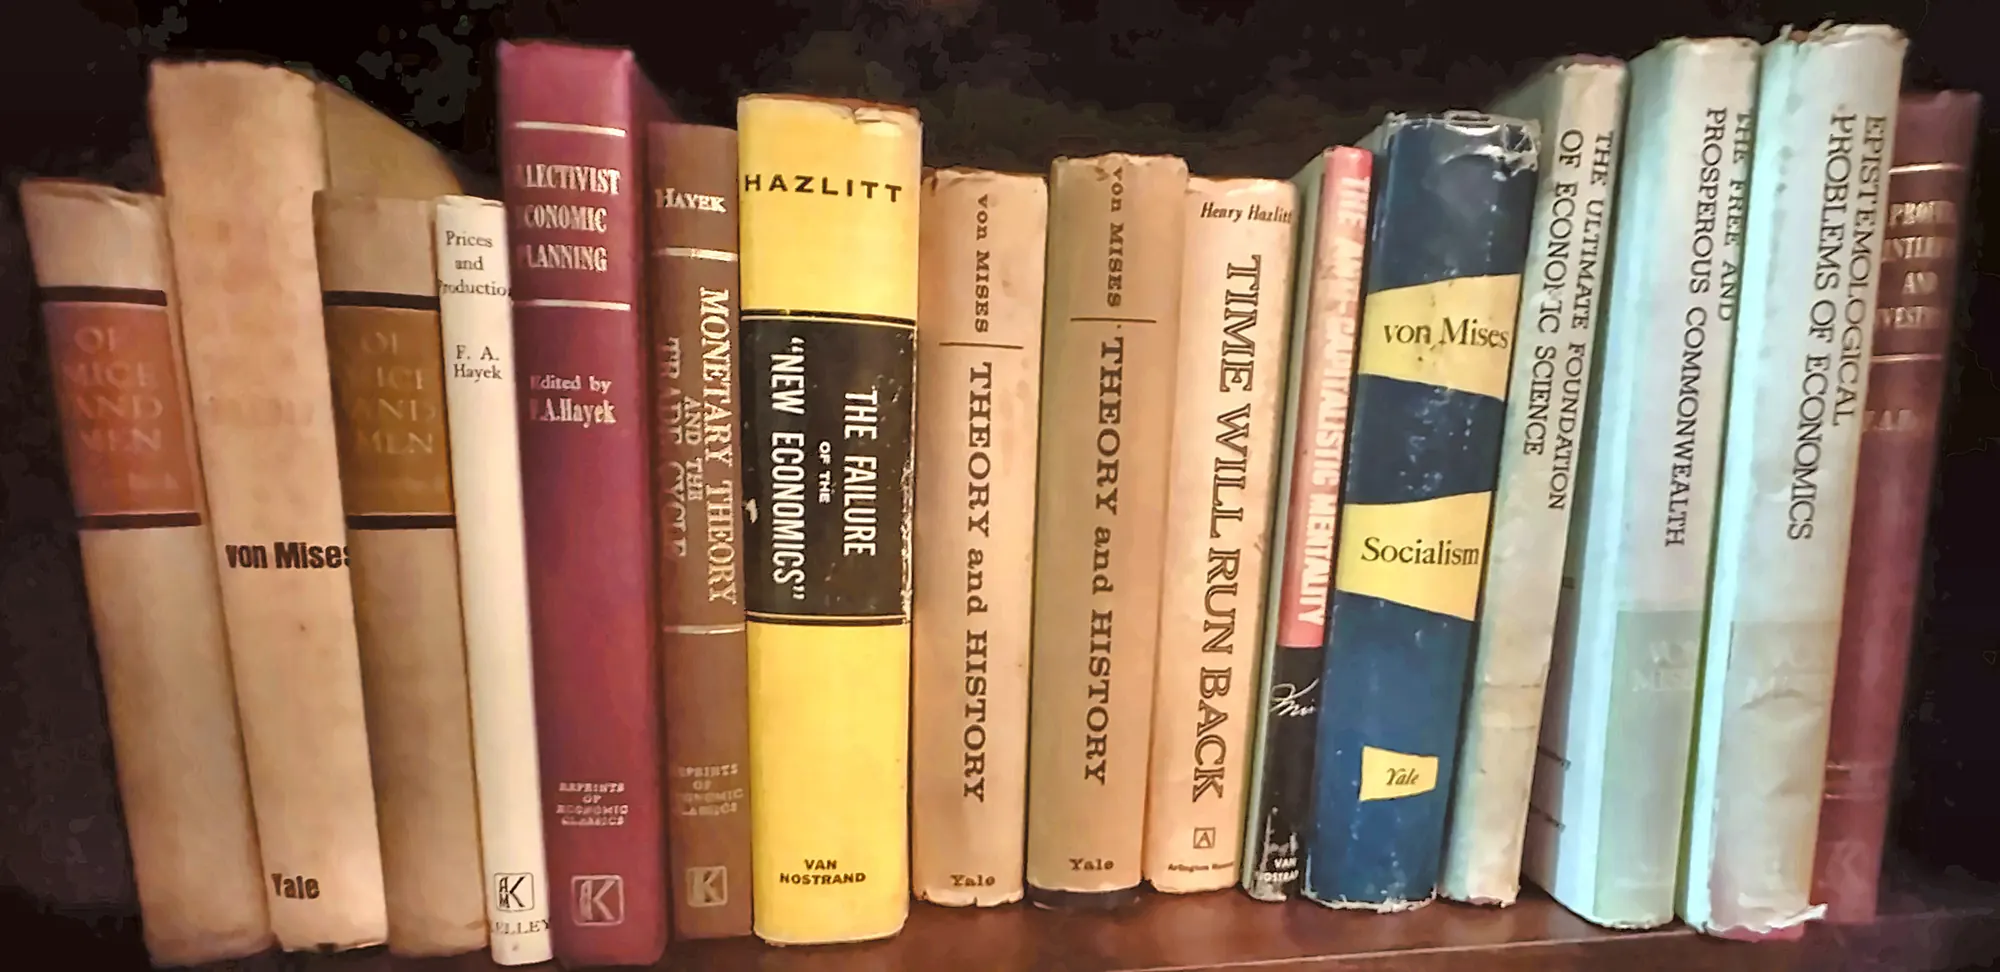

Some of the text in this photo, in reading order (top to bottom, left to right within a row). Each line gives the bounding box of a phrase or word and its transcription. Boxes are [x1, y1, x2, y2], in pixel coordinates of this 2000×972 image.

[1559, 129, 1585, 169] OF
[744, 174, 903, 203] HAZLITT
[1200, 201, 1293, 225] Henry Hazlitt
[1724, 179, 1748, 247] FREE
[445, 230, 494, 248] Prices
[1106, 166, 1125, 309] von MISES
[455, 256, 484, 271] and
[974, 193, 991, 334] von MISES
[1832, 115, 1888, 427] EPISTEMOLOGICAL
[1718, 259, 1738, 322] AND
[1384, 317, 1509, 349] von Mises
[1548, 131, 1614, 510] THE ULTIMATE FOUNDATION
[1664, 107, 1728, 548] PROSPEROUS COMMONWEALTH
[1787, 113, 1858, 542] PROBLEMS OF ECONOMICS
[456, 344, 501, 361] F. A.
[453, 363, 504, 384] Hayek
[590, 376, 613, 395] by
[1523, 345, 1557, 456] SCIENCE
[684, 396, 704, 501] AND THE
[699, 286, 737, 605] MONETARY THEORY
[818, 440, 831, 504] OF THE
[843, 386, 878, 557] THE FAILURE
[1192, 254, 1262, 803] TIME WILL RUN BACK
[225, 544, 269, 569] von
[1083, 336, 1124, 786] THEORY and HISTORY
[1297, 493, 1338, 626] MENTALITY
[1360, 537, 1480, 566] Socialism
[963, 361, 993, 804] THEORY and HISTORY
[1386, 767, 1420, 786] Yale
[779, 872, 867, 886] NOSTRAND
[803, 858, 838, 871] VAN
[949, 874, 996, 887] Yale
[1068, 857, 1115, 871] Yale
[1273, 857, 1298, 869] VAN
[271, 873, 320, 900] Yale
